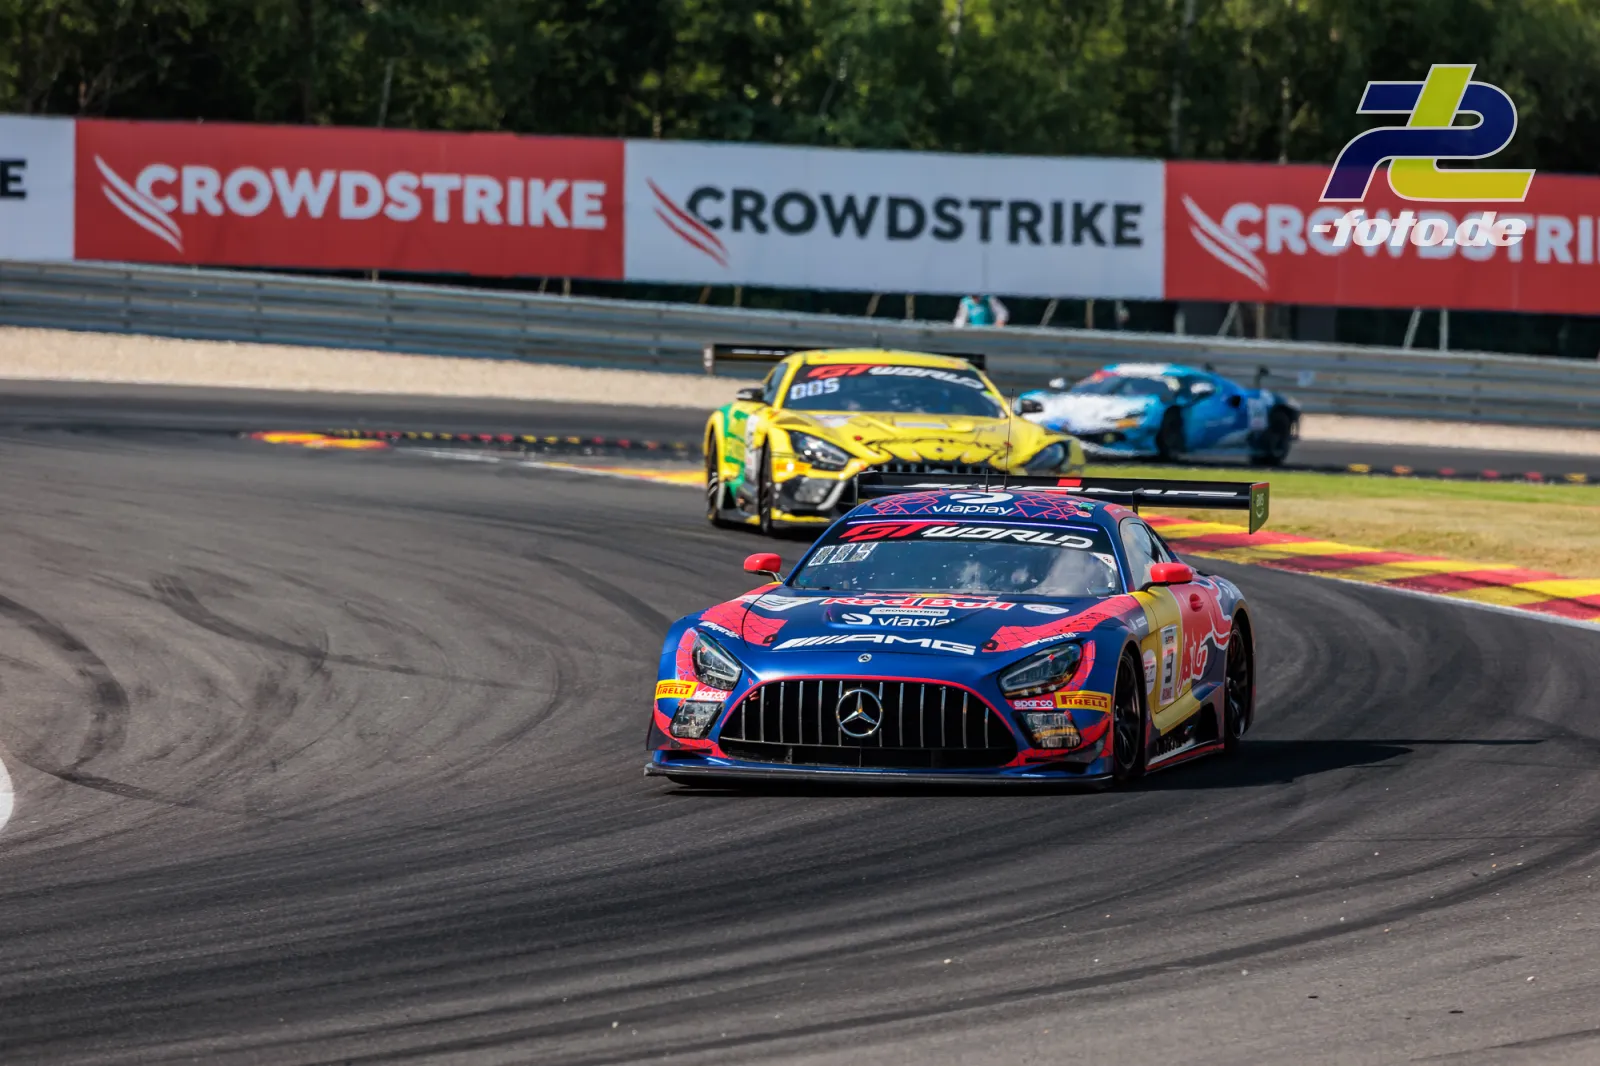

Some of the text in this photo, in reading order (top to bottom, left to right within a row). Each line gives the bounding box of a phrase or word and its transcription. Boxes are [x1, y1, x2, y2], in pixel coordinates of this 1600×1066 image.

[136, 164, 607, 230] CROWDSTRIKE
[687, 184, 1142, 247] CROWDSTRIKE
[932, 502, 1014, 516] viaplay
[839, 521, 1094, 549] GT WORLD
[819, 596, 918, 608] Red
[915, 597, 1018, 611] Bull
[657, 683, 692, 695] PIRELLI
[1013, 699, 1054, 709] sparco
[1060, 694, 1108, 709] PIRELLI
